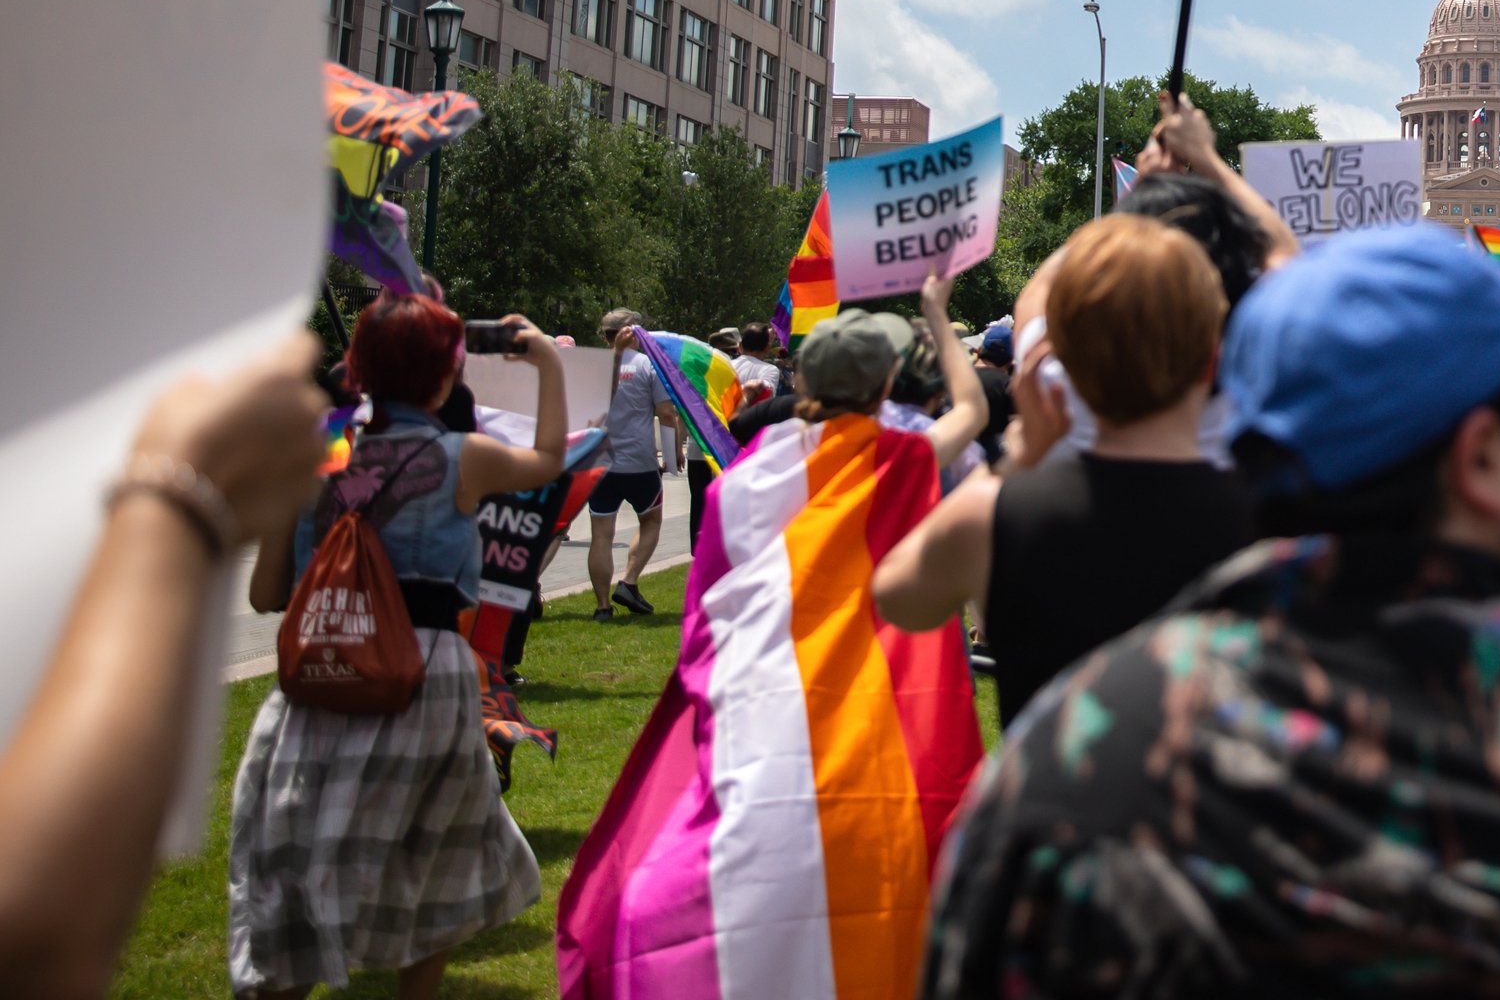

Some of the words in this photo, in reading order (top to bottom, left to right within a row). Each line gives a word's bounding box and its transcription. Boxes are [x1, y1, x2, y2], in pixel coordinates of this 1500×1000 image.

[877, 142, 973, 188] TRANS
[1290, 145, 1364, 190] WE
[875, 177, 978, 228] PEOPLE
[1265, 180, 1419, 235] ELONG
[875, 214, 978, 265] BELONG
[477, 501, 543, 538] ANS
[303, 663, 356, 677] TEXAS
